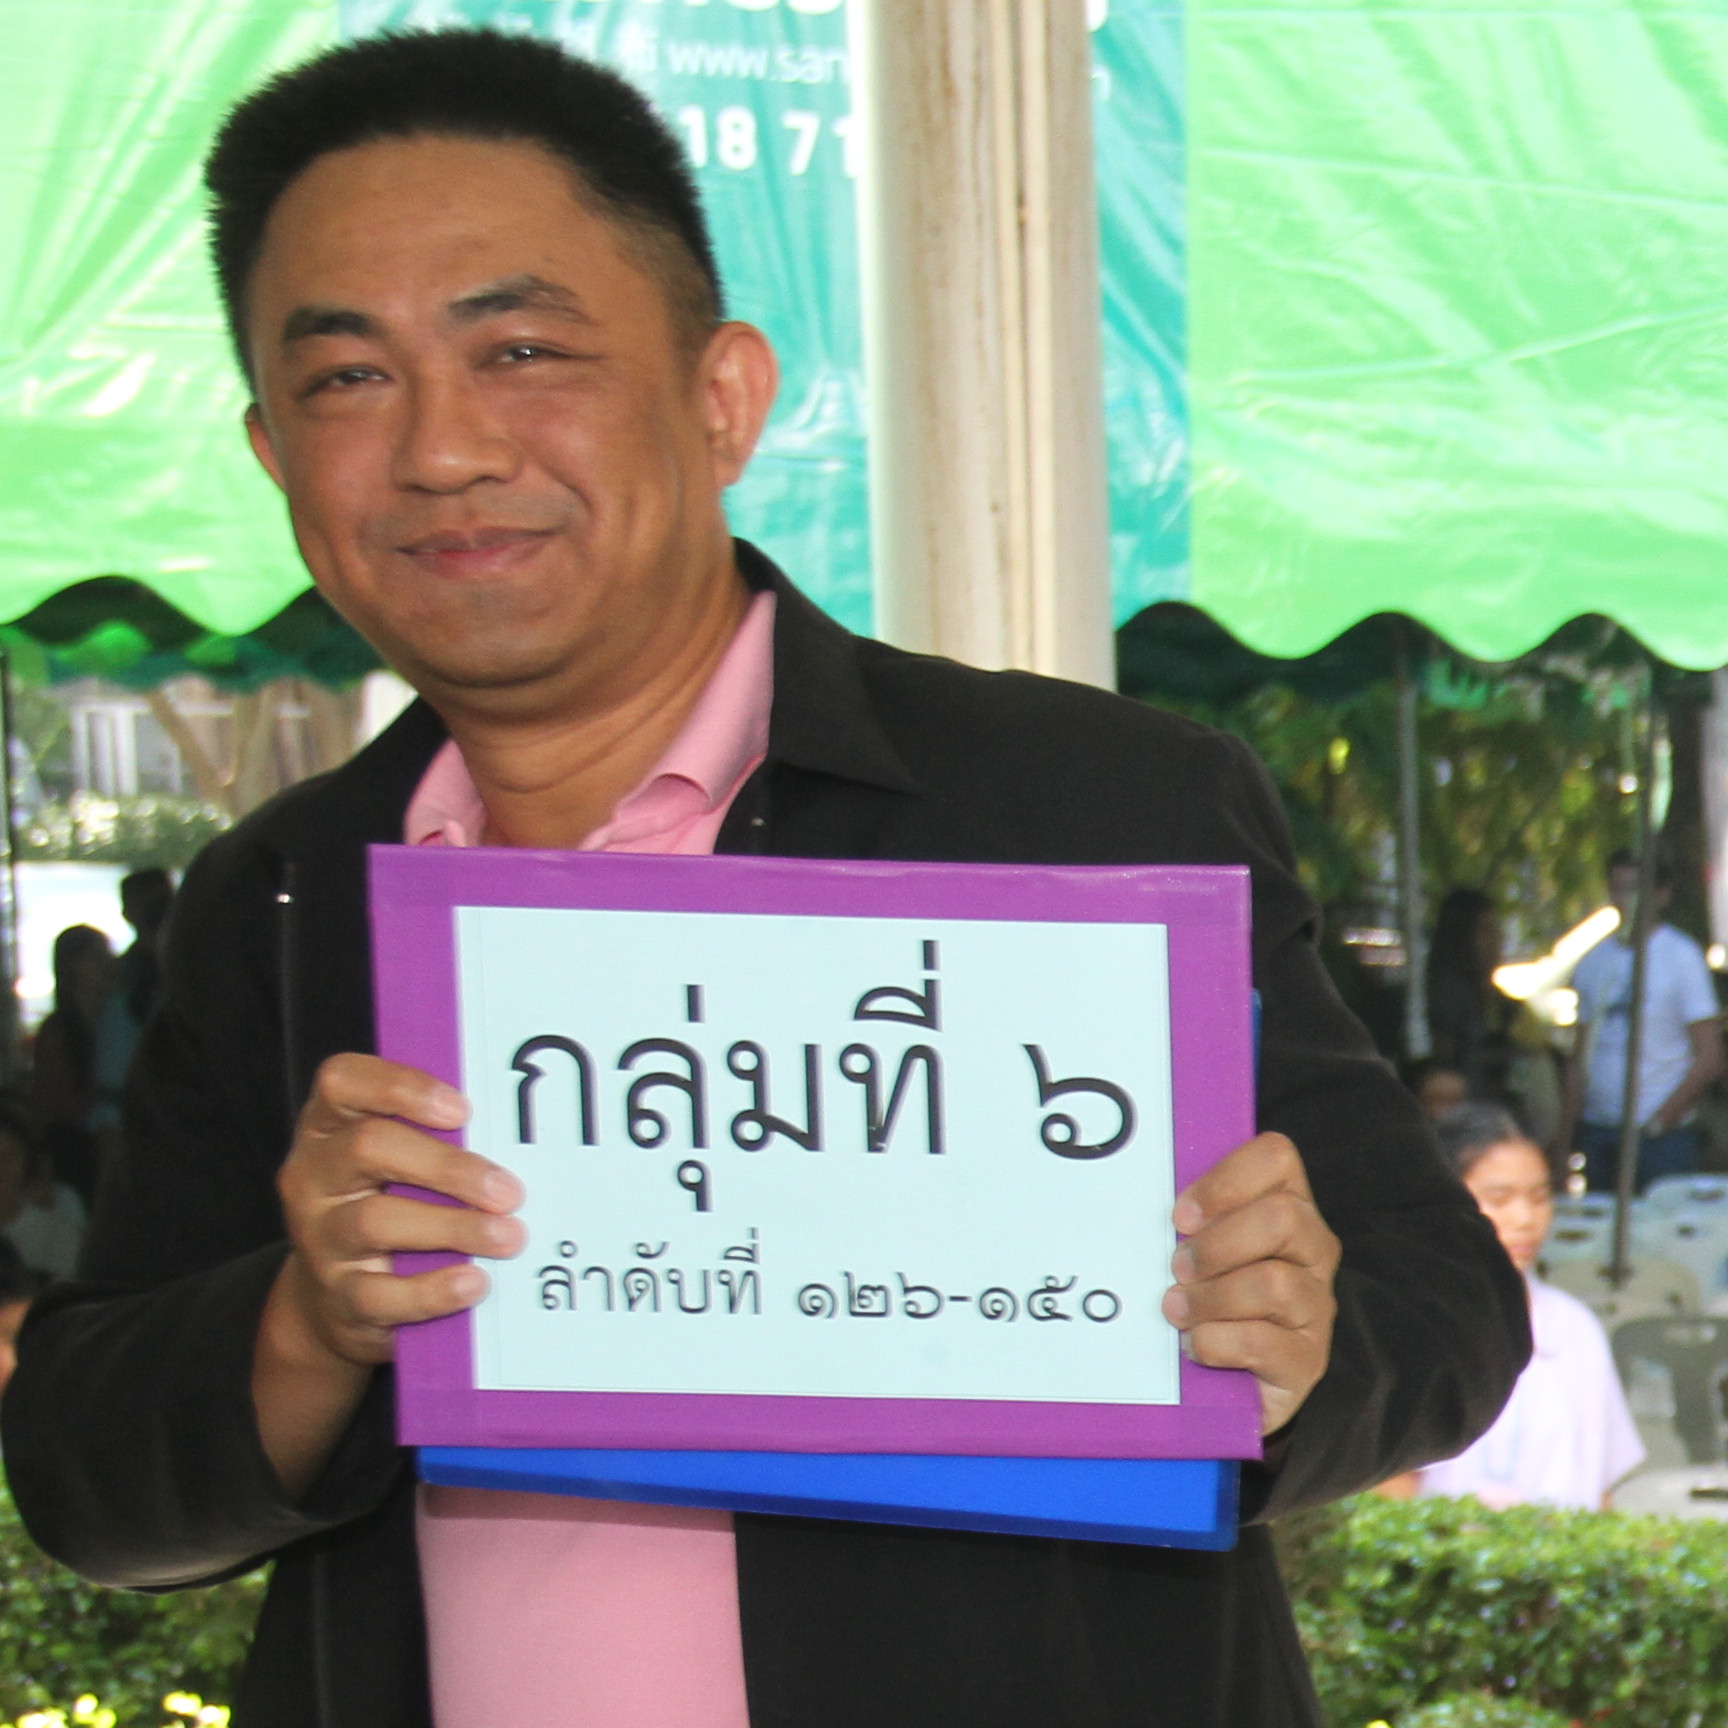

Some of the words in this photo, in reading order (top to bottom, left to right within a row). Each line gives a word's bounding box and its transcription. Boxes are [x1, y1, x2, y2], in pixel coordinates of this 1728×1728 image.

[509, 938, 946, 1213] กลุ่มที่
[1021, 1043, 1138, 1161] ๖
[536, 1226, 762, 1316] ลำดับที่
[796, 1270, 1122, 1324] ๑๒๖-๑๕๐
